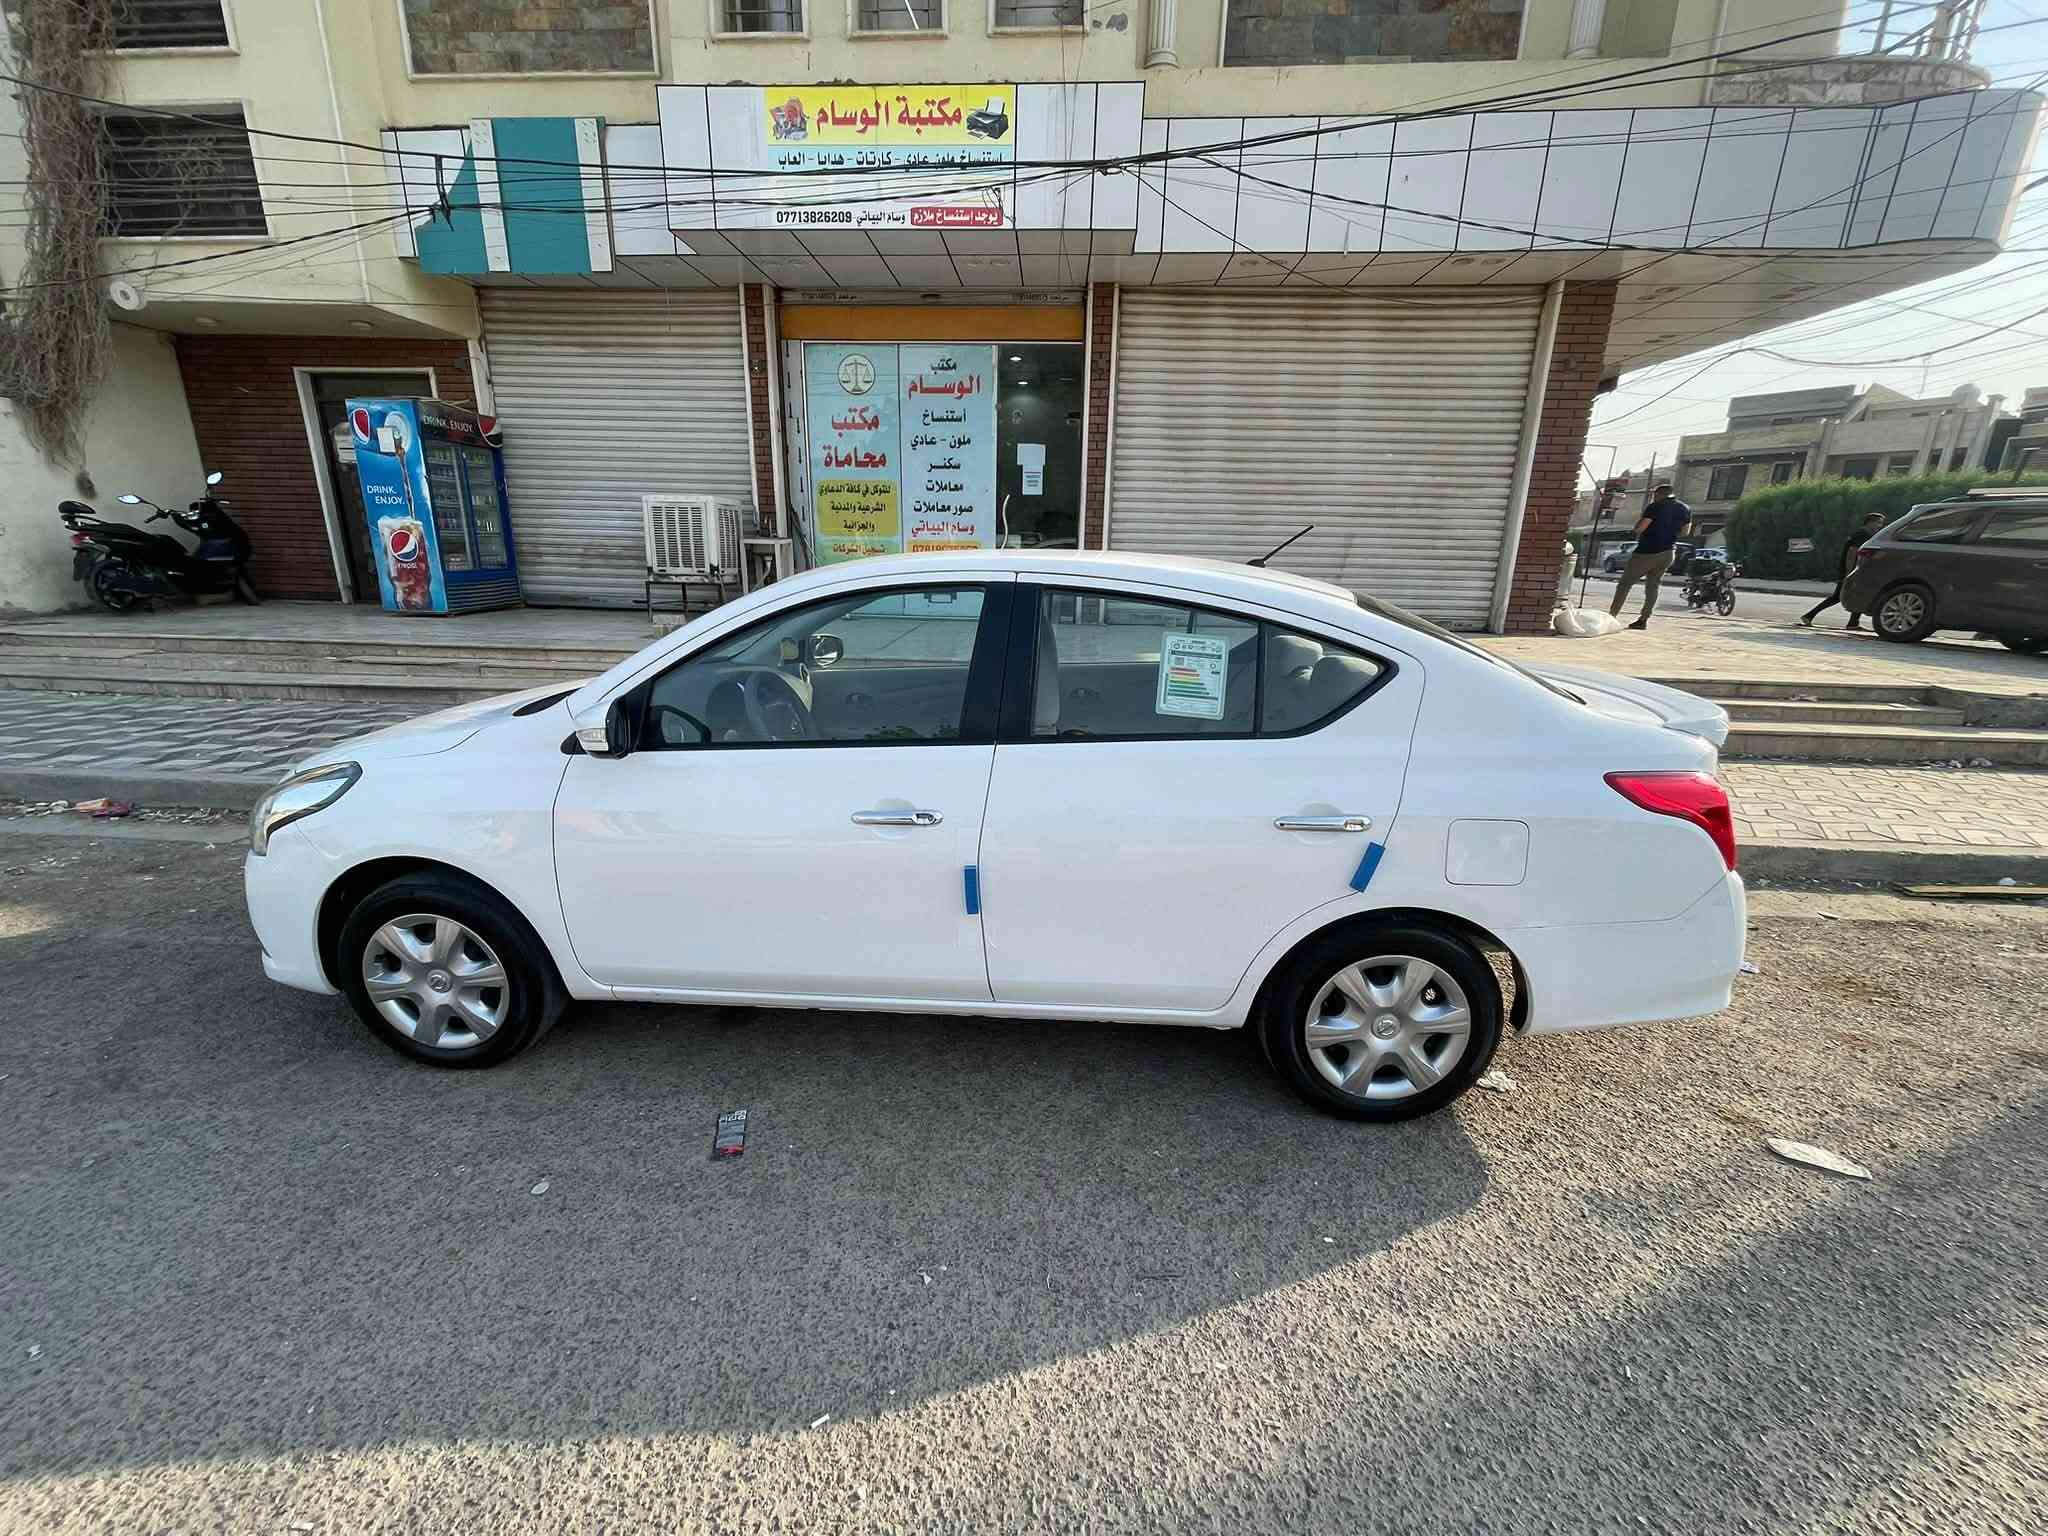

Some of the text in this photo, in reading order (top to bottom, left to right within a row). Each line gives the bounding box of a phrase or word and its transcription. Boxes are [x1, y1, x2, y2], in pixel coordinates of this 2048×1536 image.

[816, 95, 962, 134] مكتبة الوسام
[778, 152, 805, 170] العاب
[817, 152, 845, 168] هدايا
[856, 151, 892, 168] كارتات
[776, 210, 906, 228] وسام البياتي 07713826209
[913, 209, 935, 224] ملازم
[974, 211, 999, 225] يوجد
[930, 358, 957, 375] مكتب
[908, 374, 980, 400] الوسام
[831, 406, 880, 438] مكتب
[911, 434, 971, 450] ملون عادي
[822, 444, 887, 468] محاماة
[926, 479, 964, 493] معاملات
[375, 496, 405, 504] ENJOY.
[857, 501, 886, 514] الشرعية
[914, 500, 974, 516] صور معاملات
[911, 520, 975, 537] وسام البياتي
